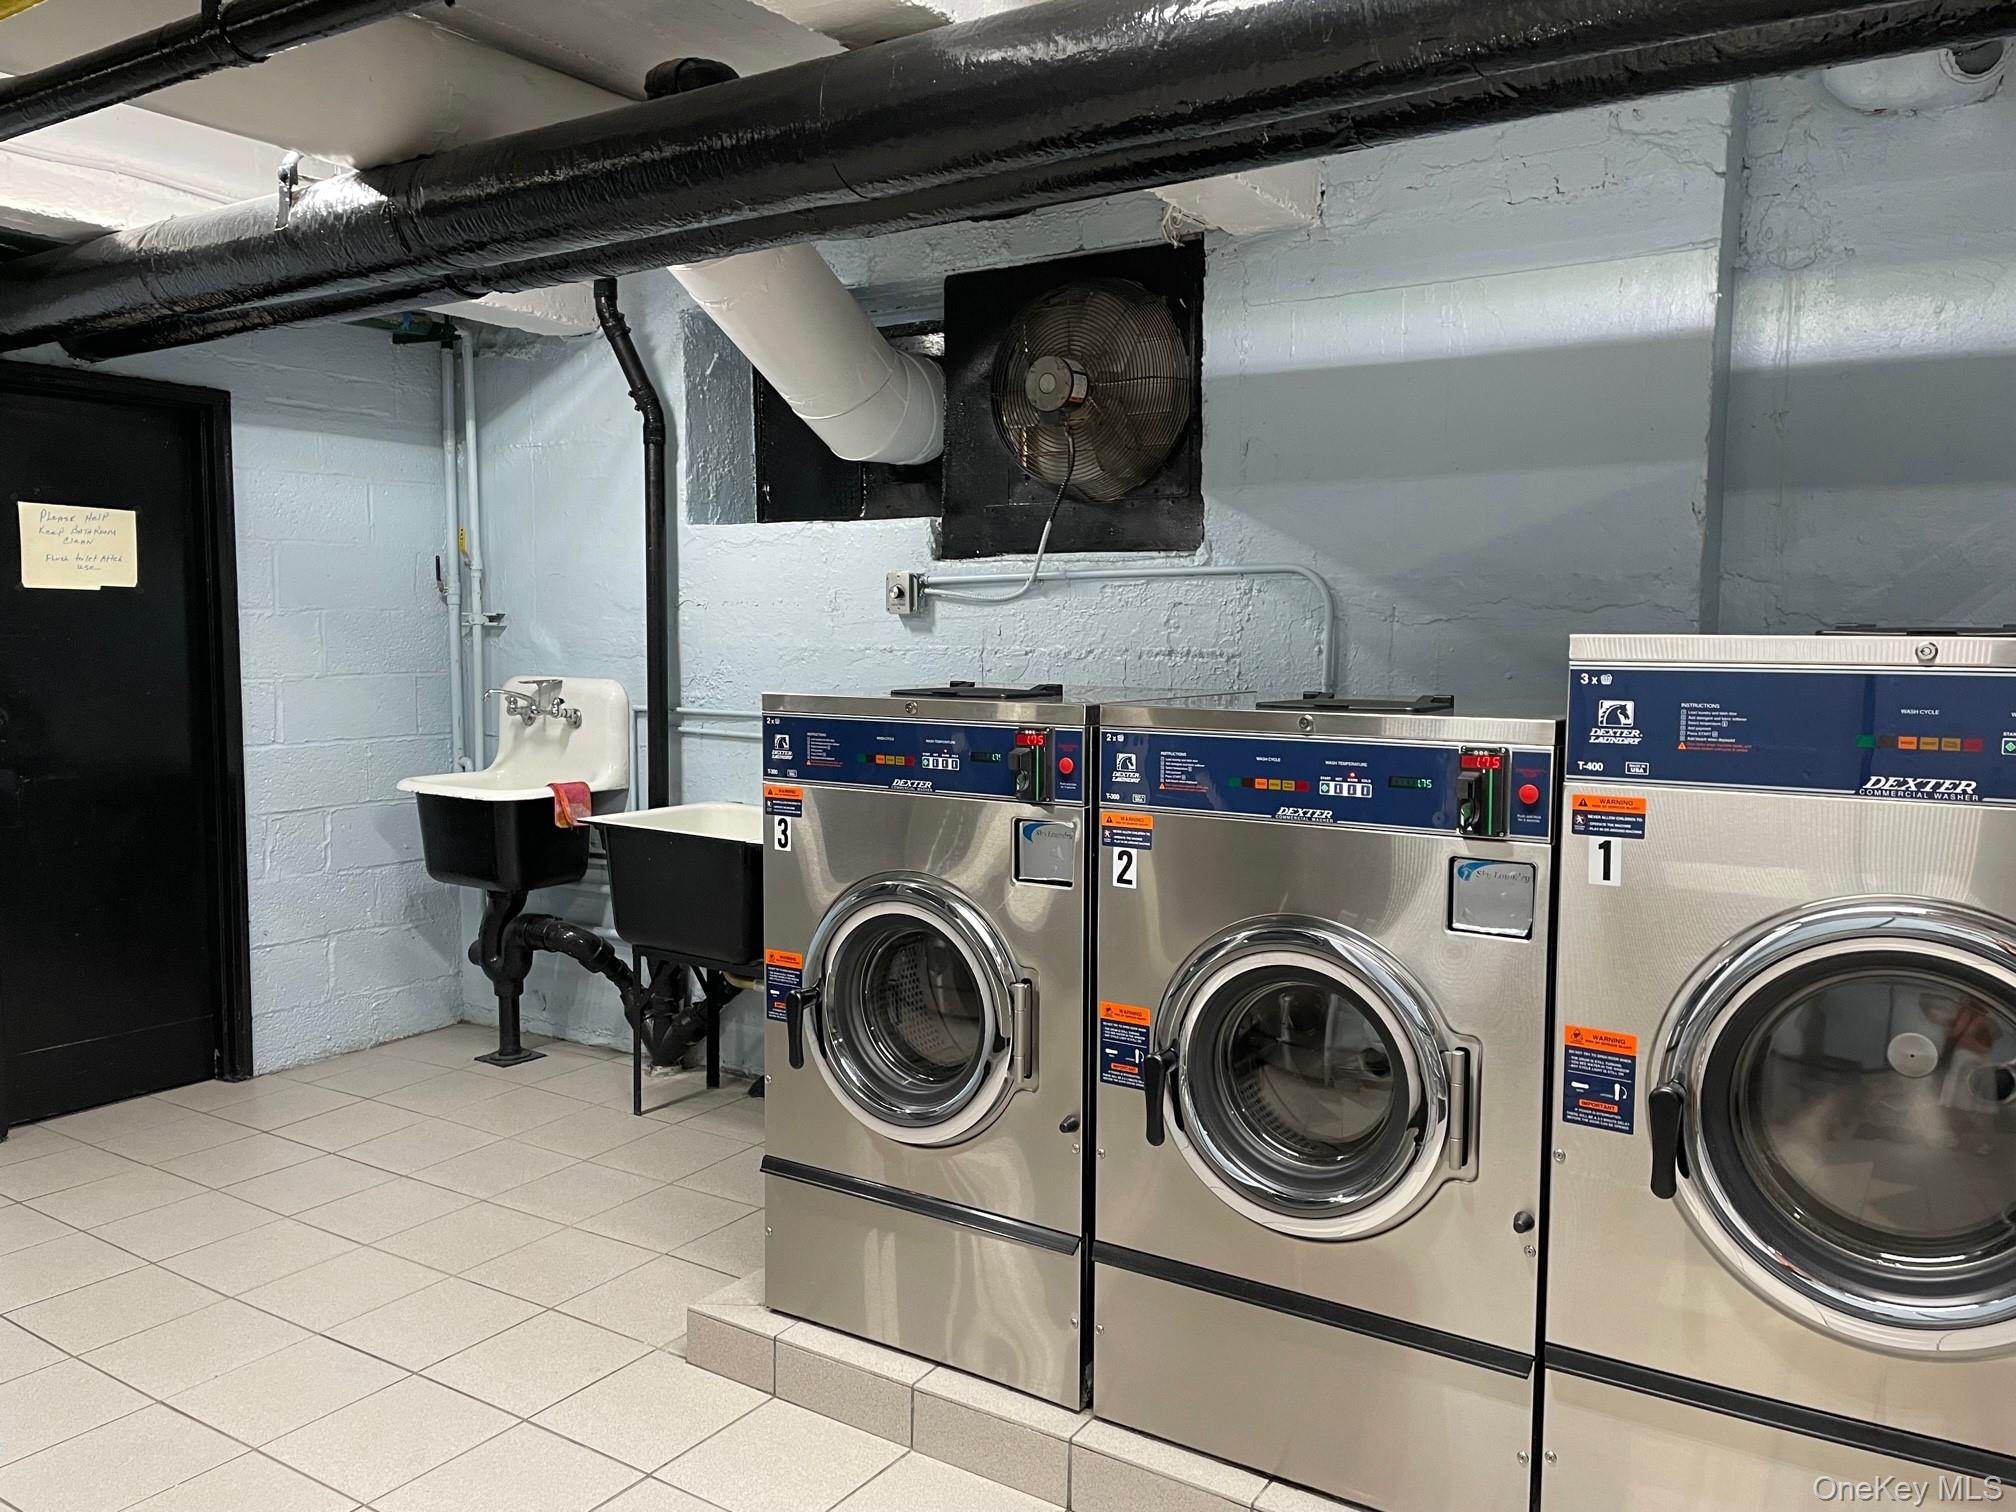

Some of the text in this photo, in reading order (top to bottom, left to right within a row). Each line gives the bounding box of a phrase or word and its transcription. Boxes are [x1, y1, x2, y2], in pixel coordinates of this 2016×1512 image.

[1580, 673, 1599, 685] 3 x
[766, 717, 771, 725] 2
[1106, 733, 1112, 742] 2
[1589, 728, 1641, 738] DEXTER
[1589, 736, 1643, 745] LAUNDRY
[1577, 760, 1604, 772] T-400
[892, 778, 933, 789] DEXTER
[1862, 775, 1977, 794] DEXTER
[1105, 792, 1120, 801] T-300
[1859, 788, 1979, 801] COMMERCIAL WASHER
[1599, 798, 1634, 806] WARNING
[1276, 806, 1333, 819] DEXTER
[777, 817, 789, 849] 3
[1598, 840, 1612, 881] 1
[1116, 849, 1133, 886] 2
[1592, 1034, 1626, 1045] WARNING
[1581, 1100, 1616, 1112] IMPORTANT
